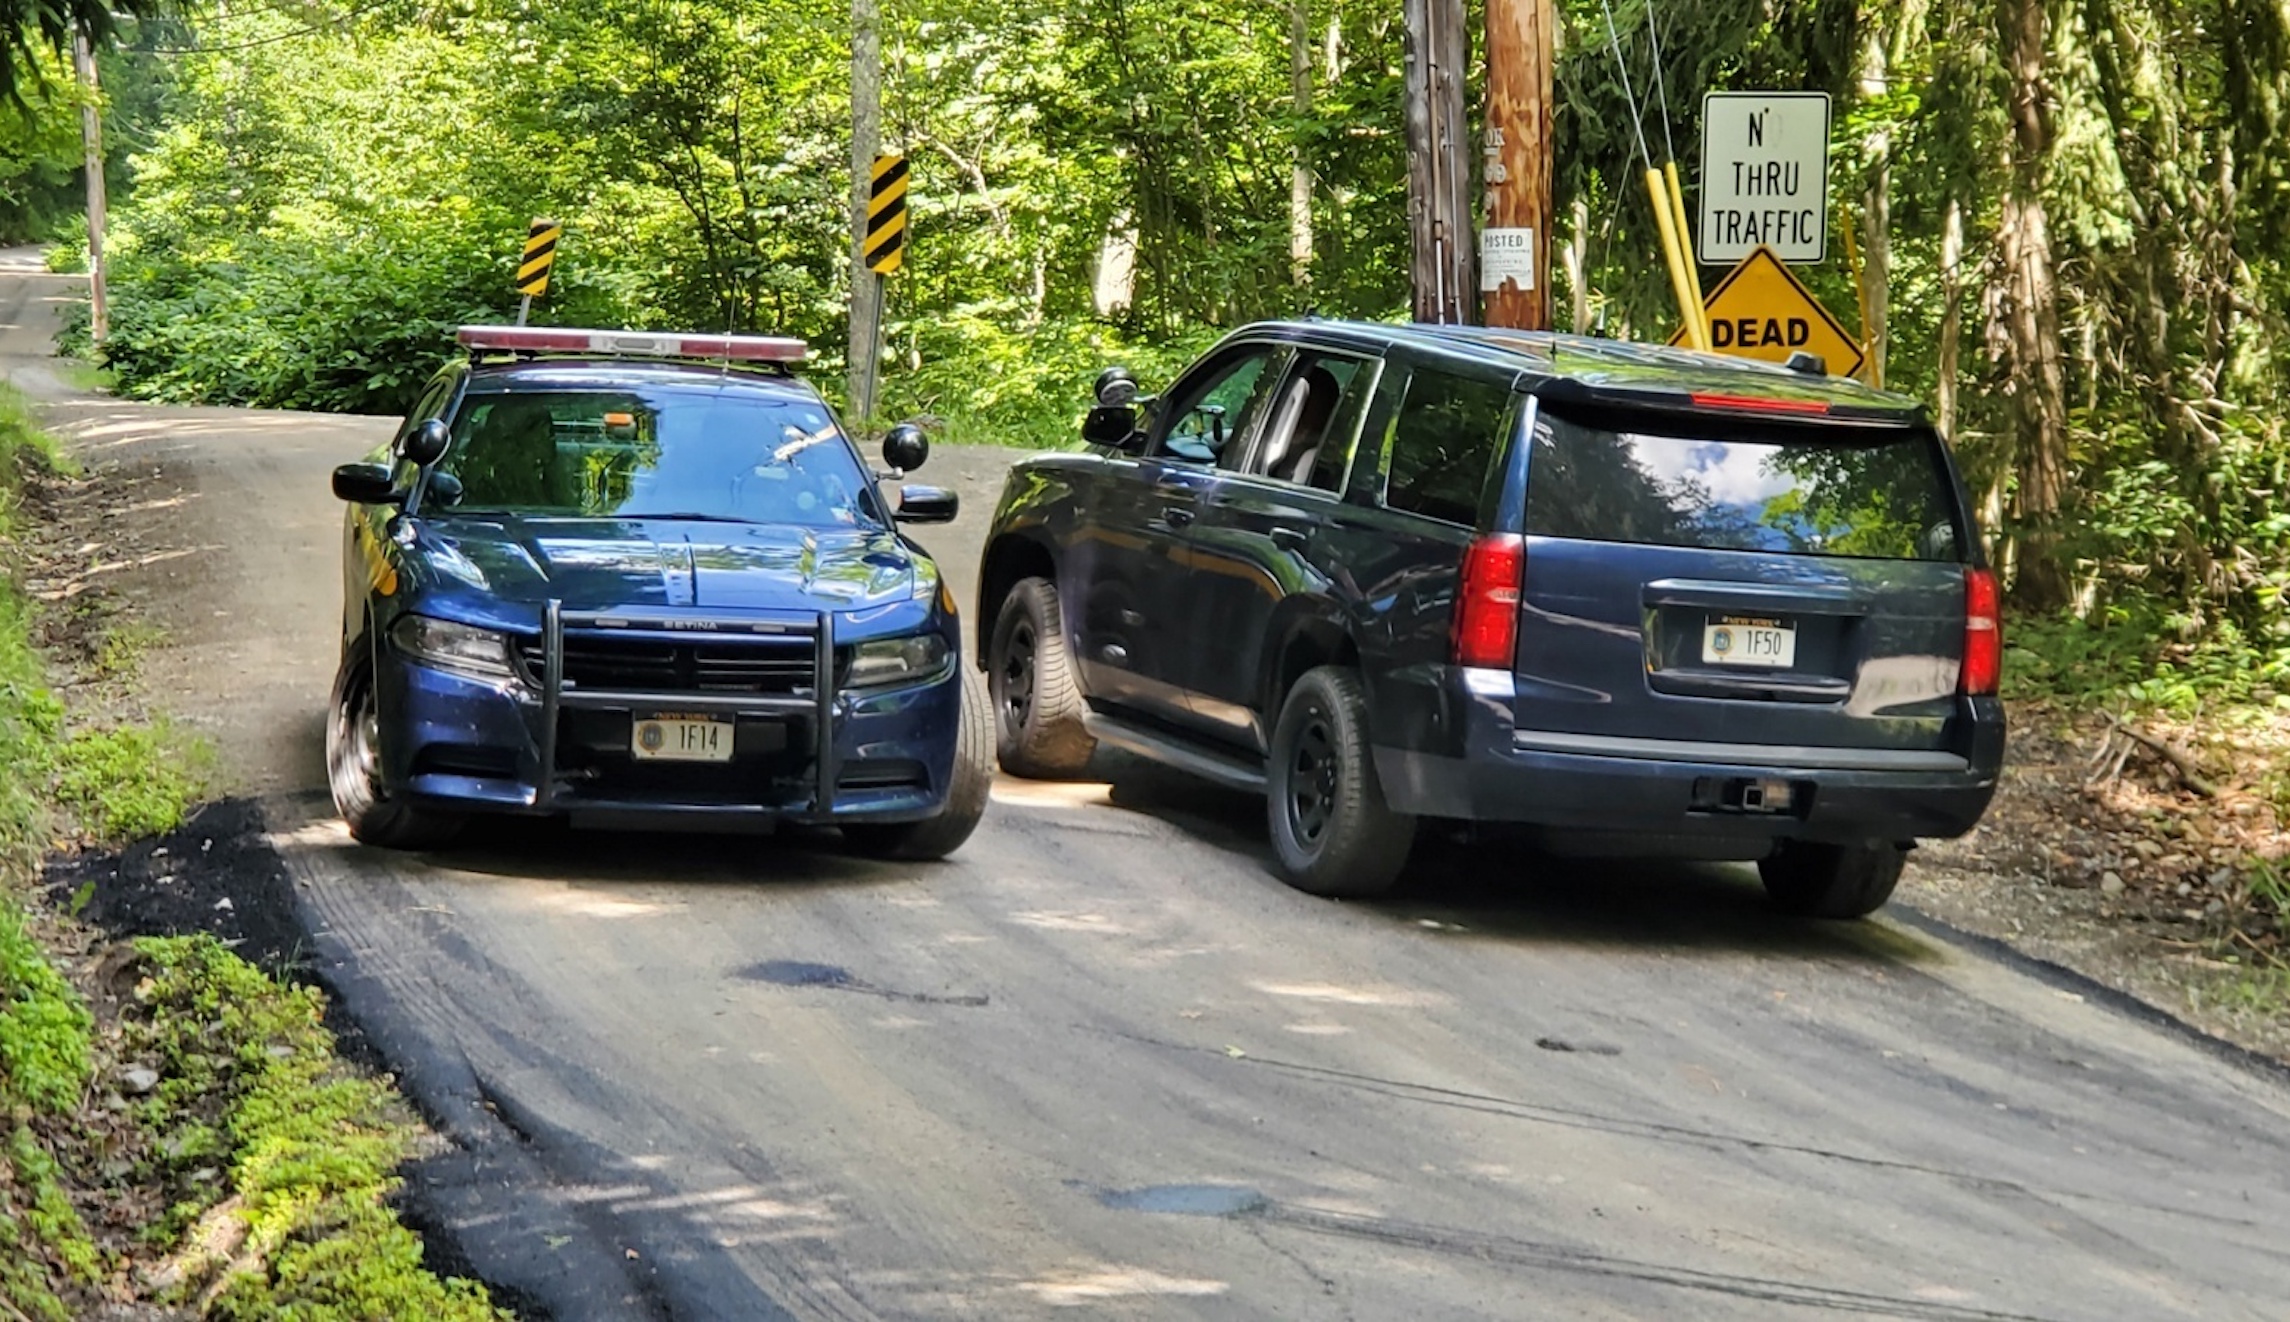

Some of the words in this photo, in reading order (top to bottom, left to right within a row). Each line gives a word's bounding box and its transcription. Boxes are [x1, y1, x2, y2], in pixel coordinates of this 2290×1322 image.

[1732, 161, 1799, 196] THRU
[1713, 210, 1814, 245] TRAFFIC
[1712, 318, 1810, 348] DEAD
[664, 620, 718, 630] SETINA
[1747, 630, 1782, 655] 1F50
[680, 724, 718, 750] 1F14
